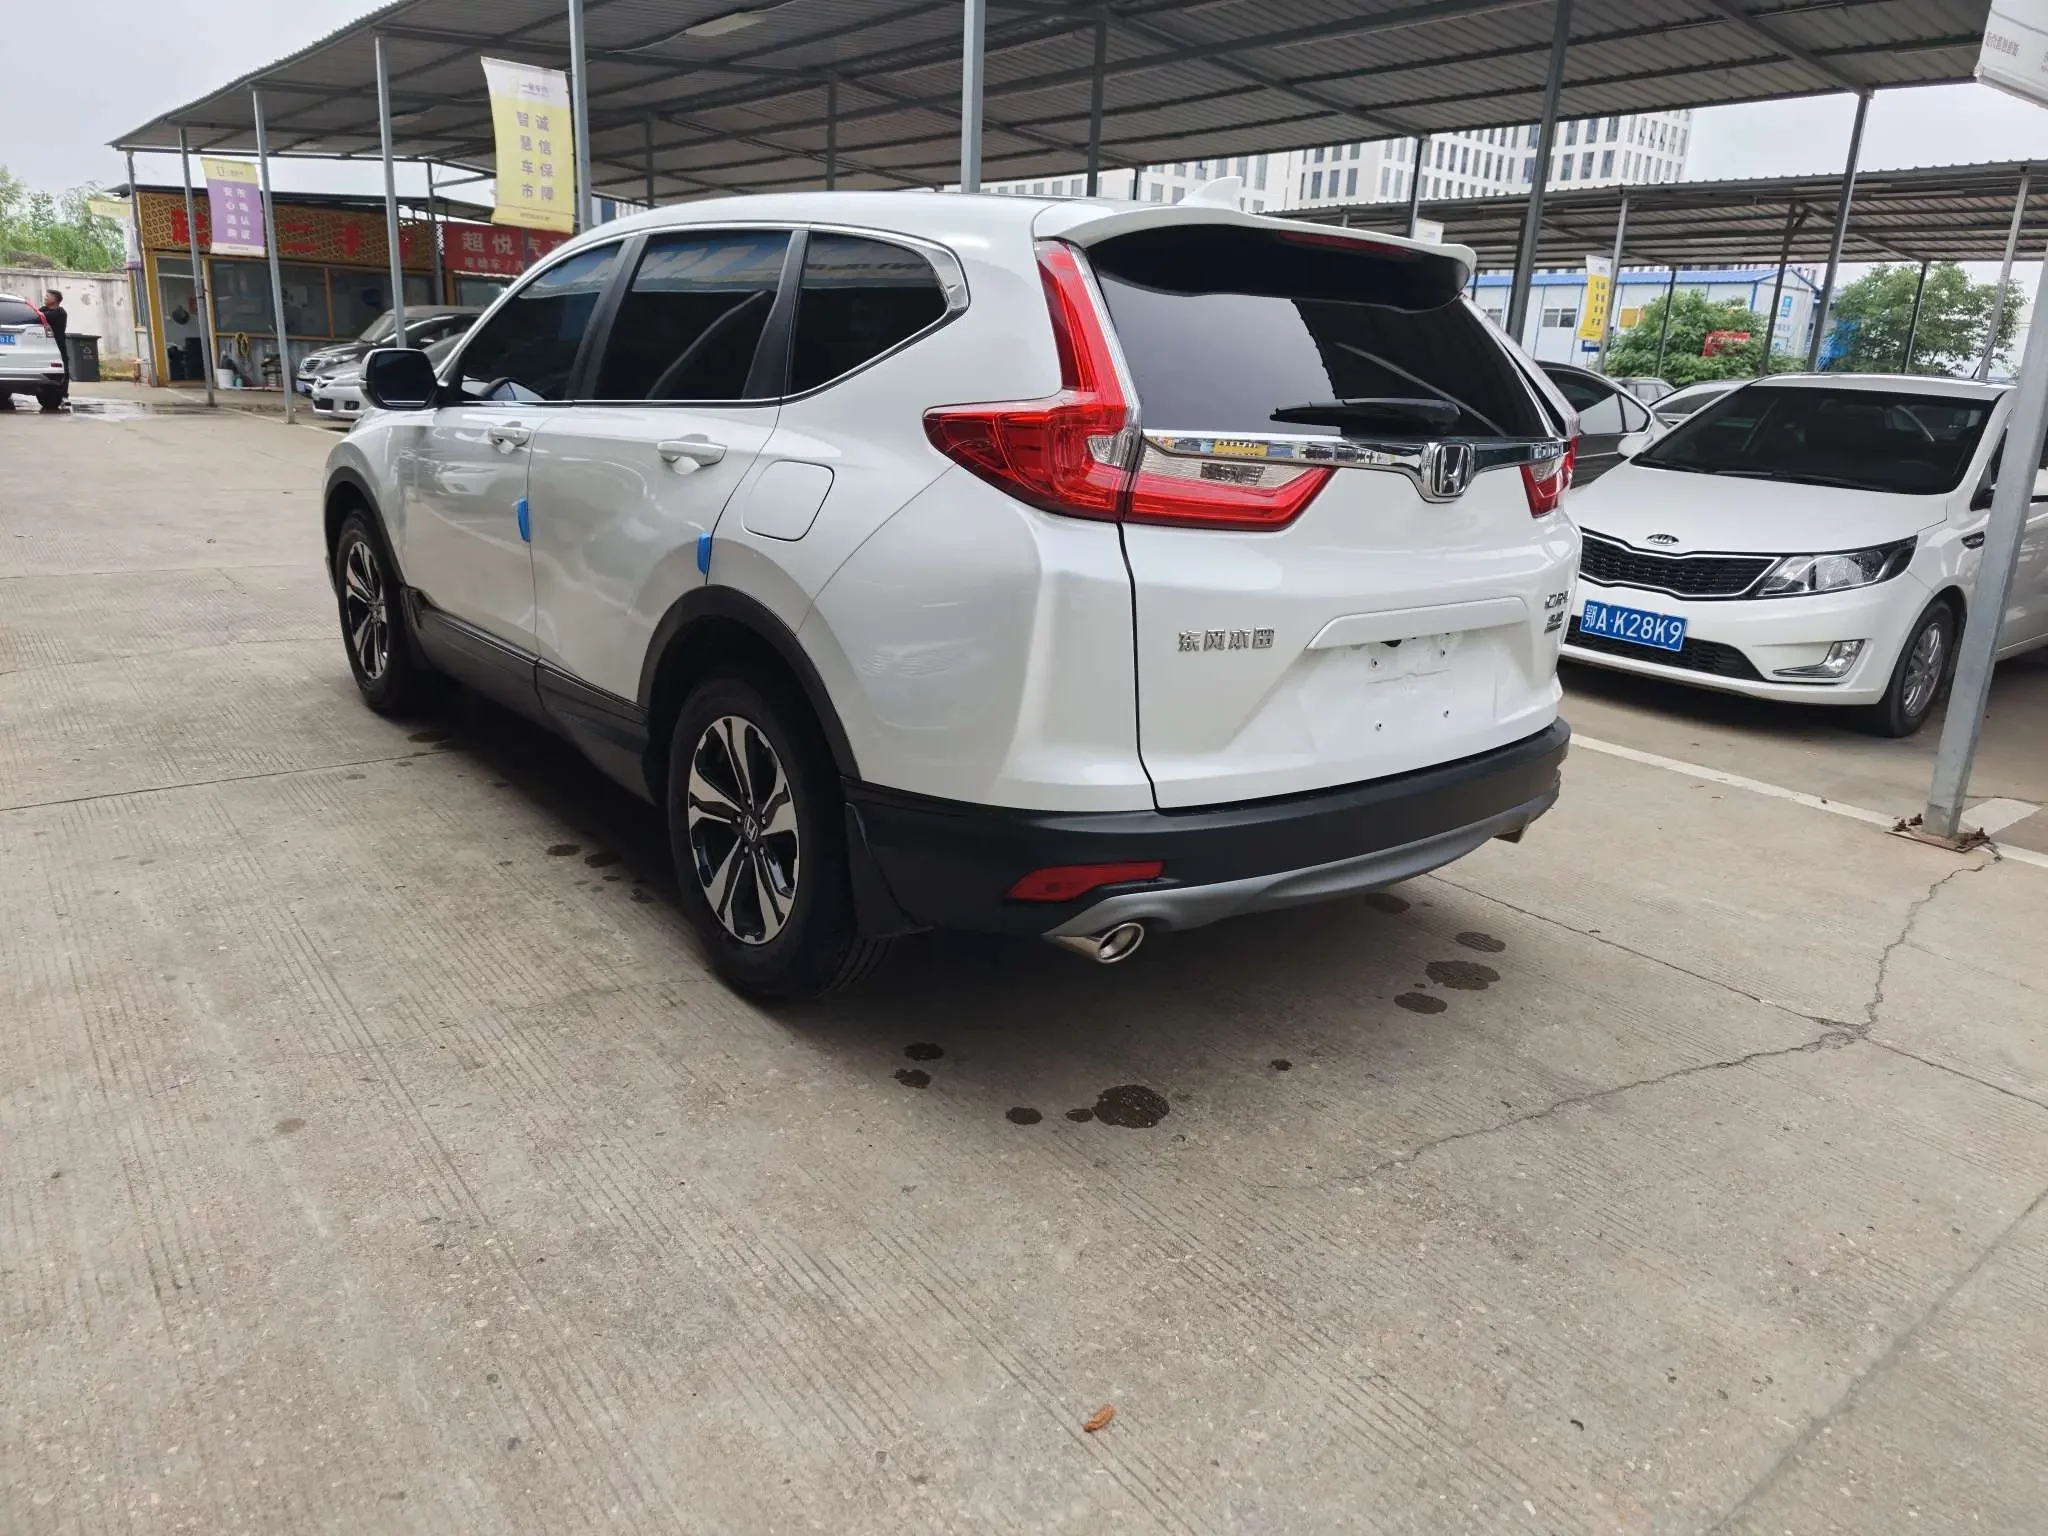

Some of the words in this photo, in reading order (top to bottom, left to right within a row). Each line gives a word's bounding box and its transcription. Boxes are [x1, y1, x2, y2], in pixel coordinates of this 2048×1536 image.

[536, 115, 555, 200] 诚信保障
[1177, 627, 1275, 653] 东风本田
